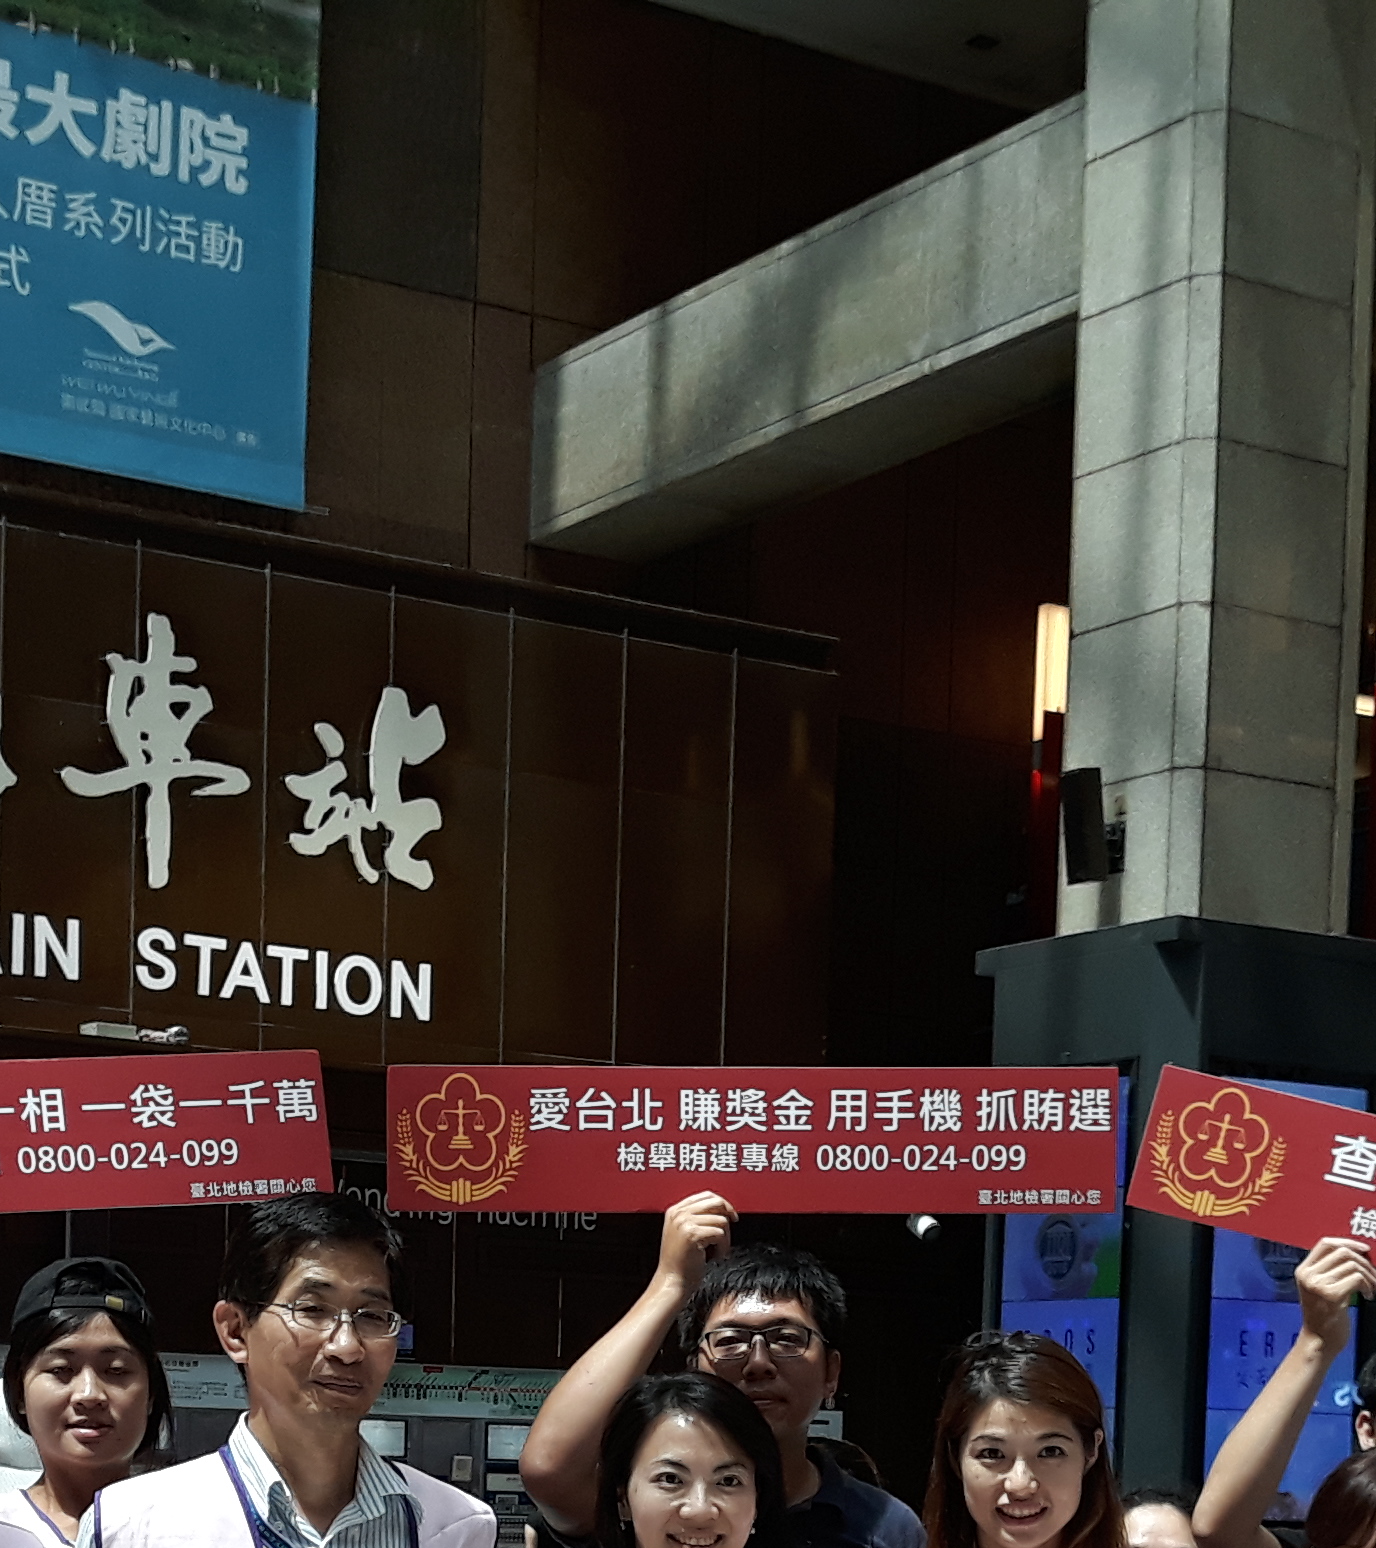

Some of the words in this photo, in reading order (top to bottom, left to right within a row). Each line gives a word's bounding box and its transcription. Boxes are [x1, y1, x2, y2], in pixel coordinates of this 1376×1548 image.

[134, 926, 433, 1023] STATION
[80, 1078, 319, 1131] 一袋一千萬
[527, 1087, 664, 1133] 愛台北
[679, 1087, 815, 1133] 賺獎金
[826, 1087, 964, 1133] 用手機
[975, 1087, 1113, 1133] 抓賄選
[16, 1138, 239, 1175] 0800-024-099
[616, 1142, 801, 1173] 檢舉賄選專線
[815, 1143, 1026, 1172] 0800-024-099
[188, 1177, 317, 1199] 臺北地檢署關心您
[976, 1189, 1102, 1207] 臺北地檢署關心您
